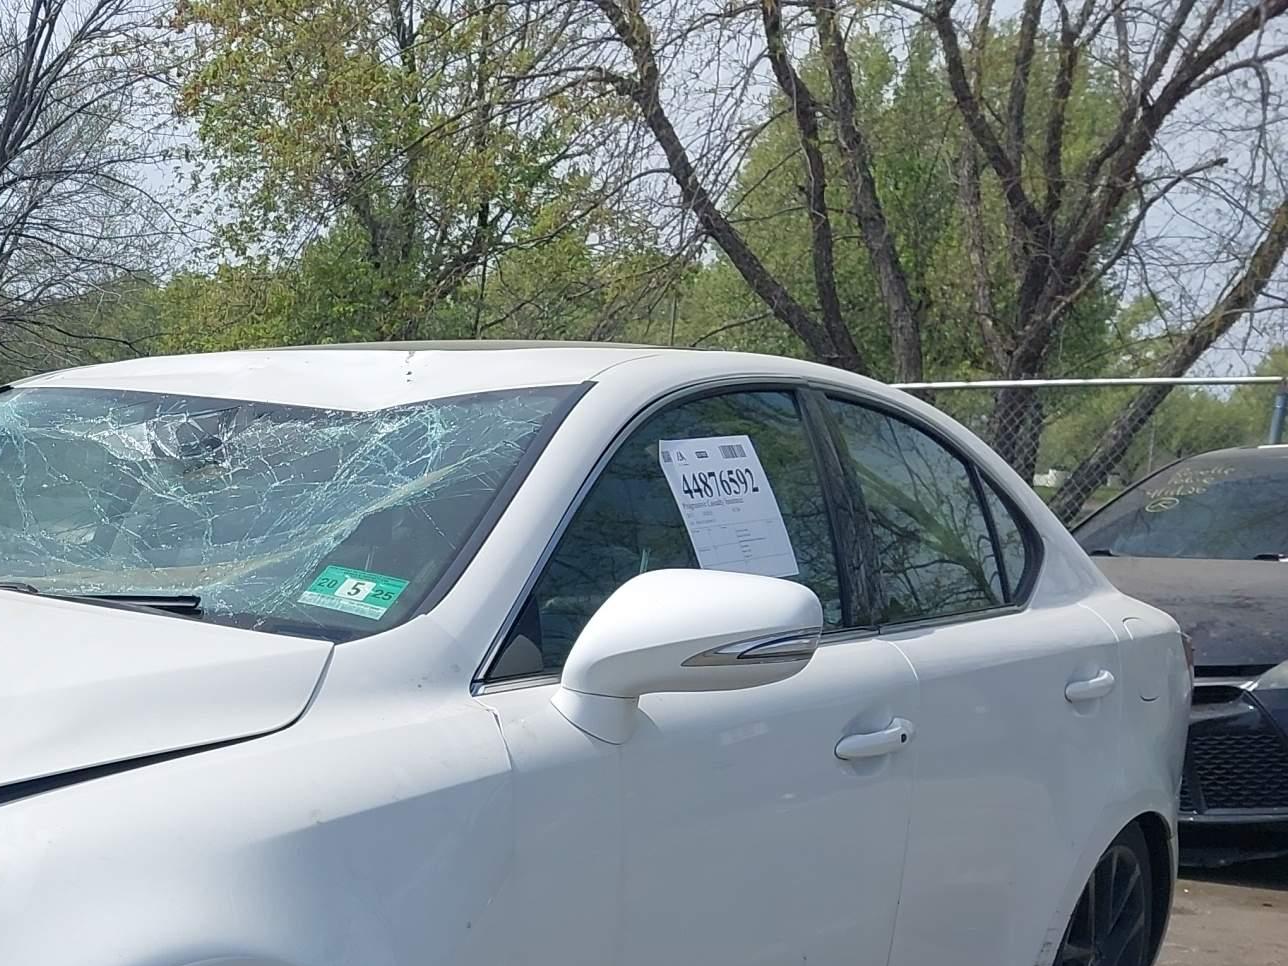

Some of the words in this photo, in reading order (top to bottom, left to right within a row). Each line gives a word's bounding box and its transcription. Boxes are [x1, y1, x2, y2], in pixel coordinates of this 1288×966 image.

[682, 468, 759, 498] 44876592
[317, 577, 338, 589] 20
[347, 581, 365, 597] 5
[371, 588, 395, 601] 25
